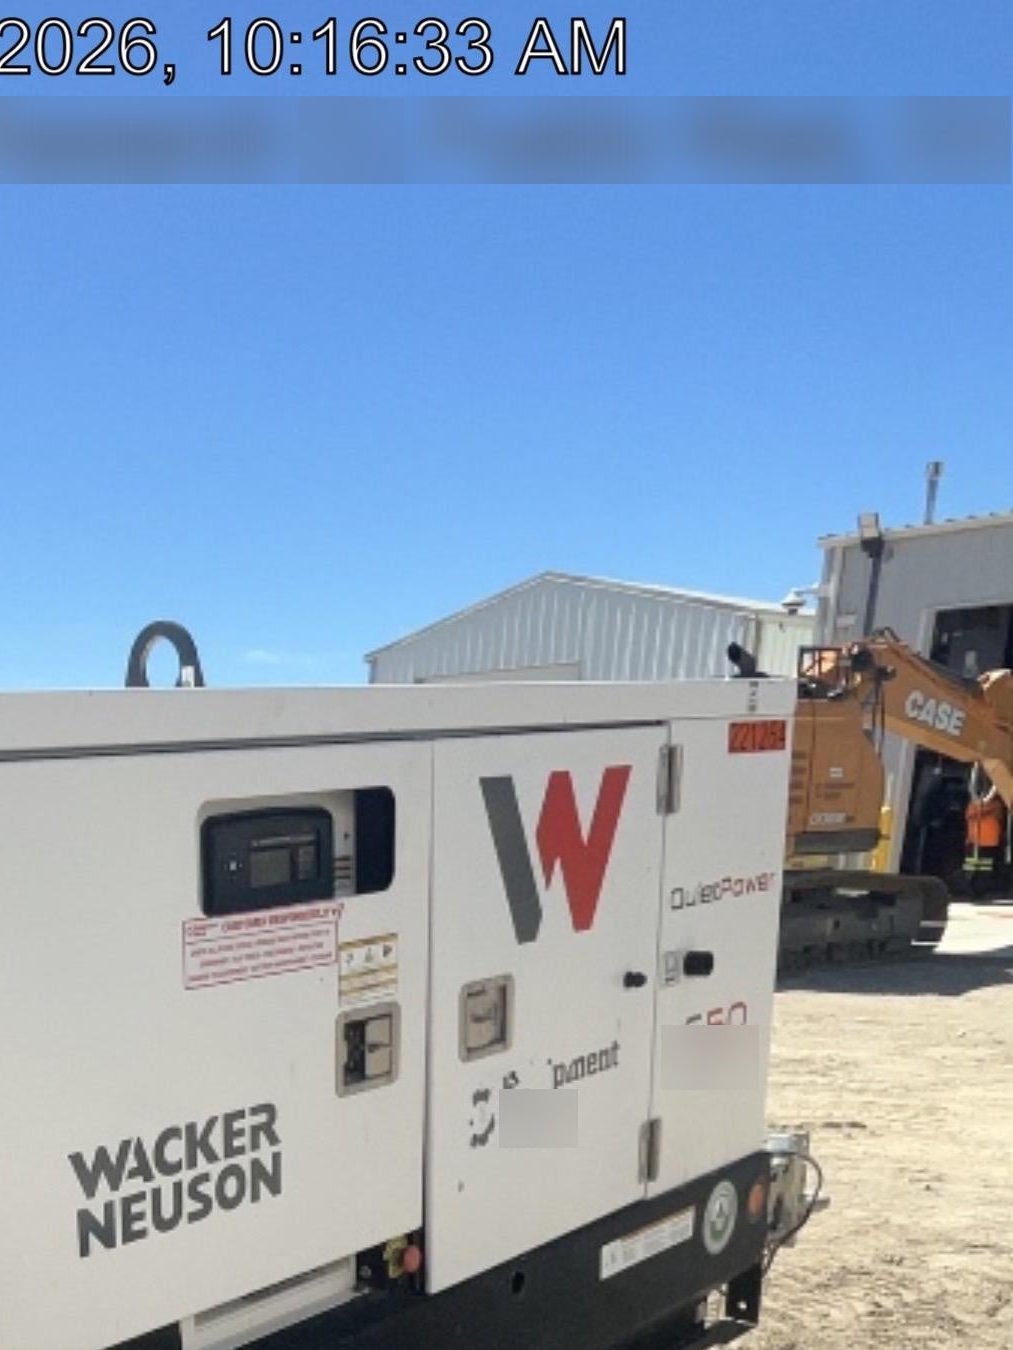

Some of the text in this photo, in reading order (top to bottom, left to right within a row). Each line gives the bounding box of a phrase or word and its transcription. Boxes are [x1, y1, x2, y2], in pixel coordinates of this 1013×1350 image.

[905, 689, 967, 737] CASE
[68, 1102, 282, 1200] WACKER
[76, 1151, 282, 1259] NEUSON
